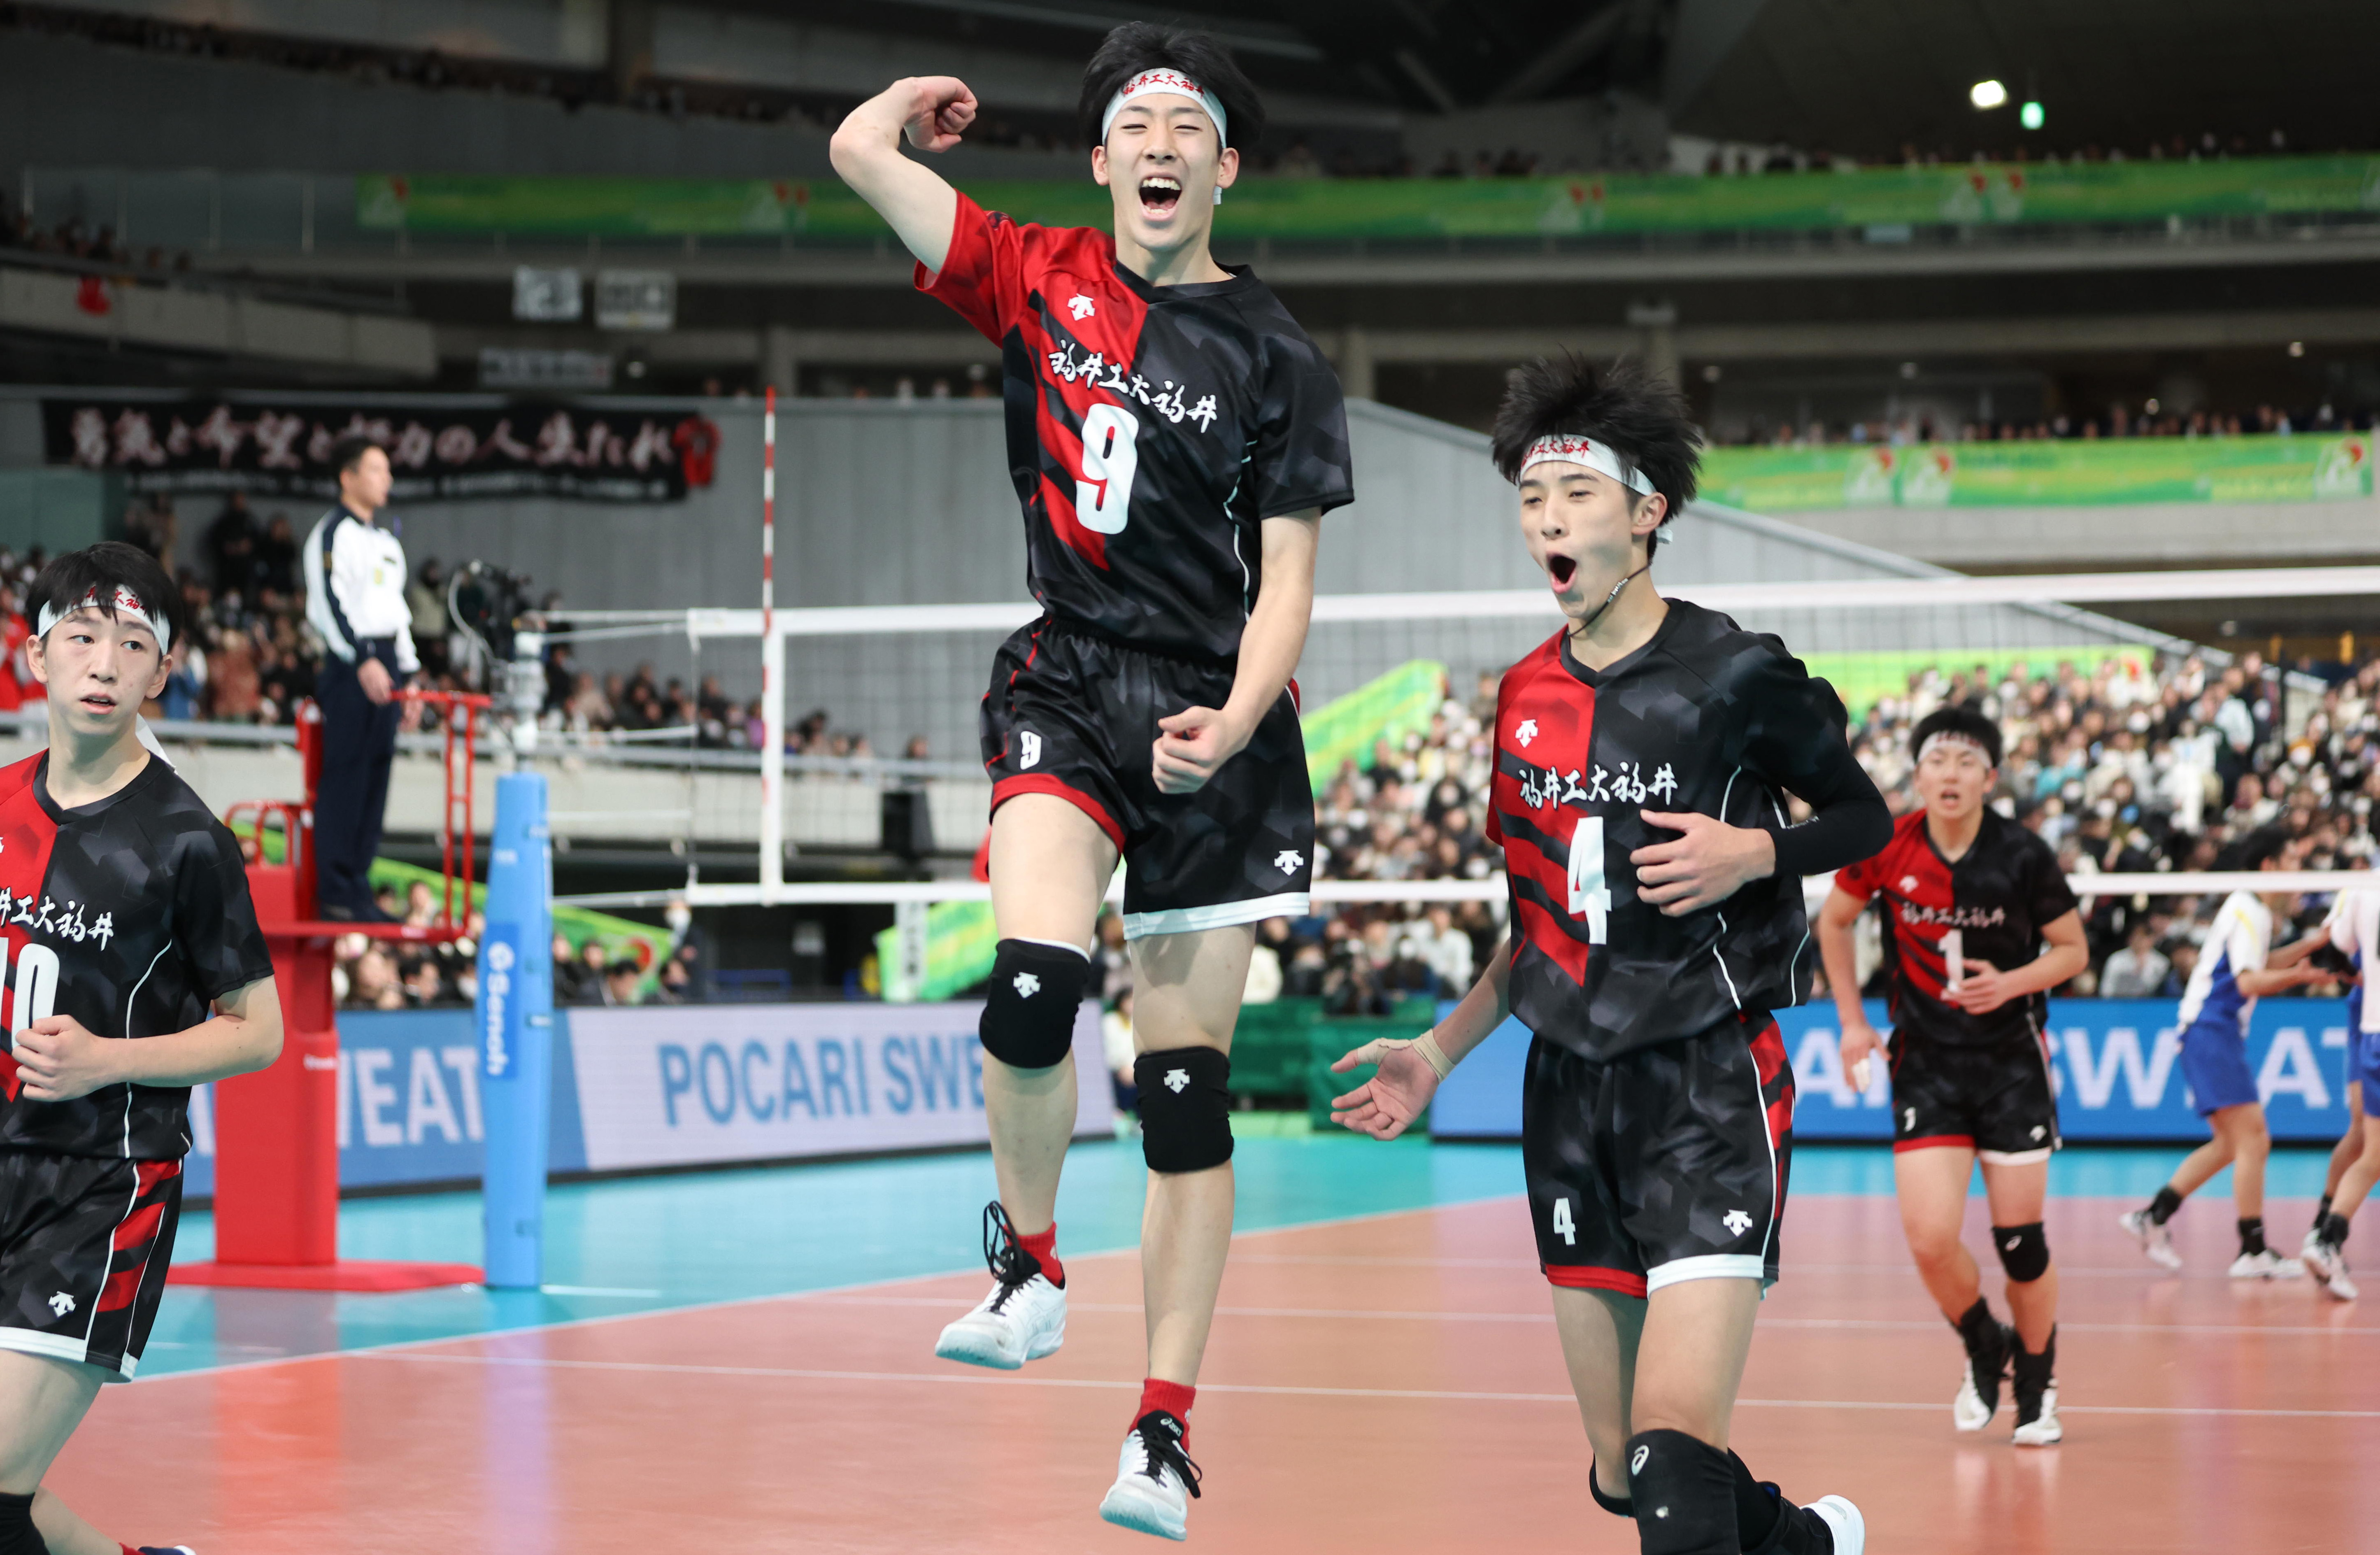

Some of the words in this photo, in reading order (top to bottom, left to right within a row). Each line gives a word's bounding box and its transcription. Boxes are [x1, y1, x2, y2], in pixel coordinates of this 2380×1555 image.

[1048, 339, 1218, 433] 福井工大福井
[1076, 403, 1139, 535] 9
[1020, 731, 1042, 770] 9
[1519, 762, 1678, 809] 福井工大福井
[1568, 816, 1612, 945] 4
[1938, 929, 1963, 991] 1
[657, 1037, 870, 1127] POCARI
[1553, 1197, 1576, 1245] 4
